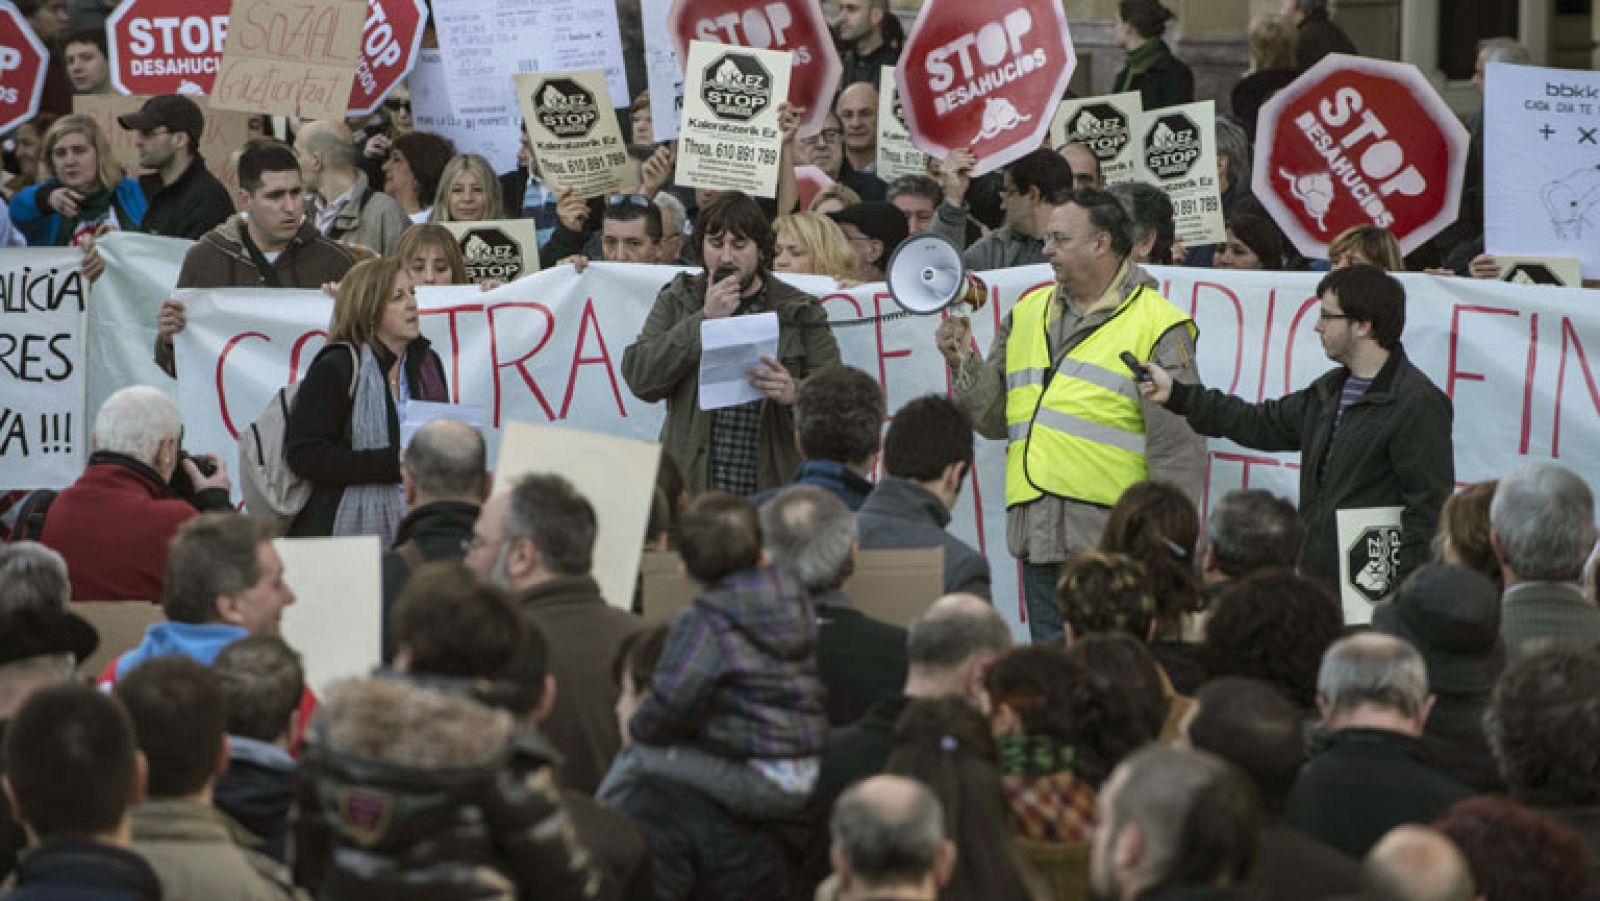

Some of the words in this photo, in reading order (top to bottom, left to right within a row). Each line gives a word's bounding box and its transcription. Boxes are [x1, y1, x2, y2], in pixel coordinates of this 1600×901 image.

[363, 0, 401, 68] TOP
[925, 8, 1032, 92] STOP
[707, 92, 766, 108] STOP
[934, 47, 1047, 117] DESAHUCIOS
[543, 113, 595, 126] STOP
[1319, 87, 1427, 197] STOP
[1151, 150, 1197, 167] STOP
[1294, 111, 1395, 229] DESAHUCIOS
[465, 264, 519, 277] STOP
[216, 297, 628, 440] CTRA
